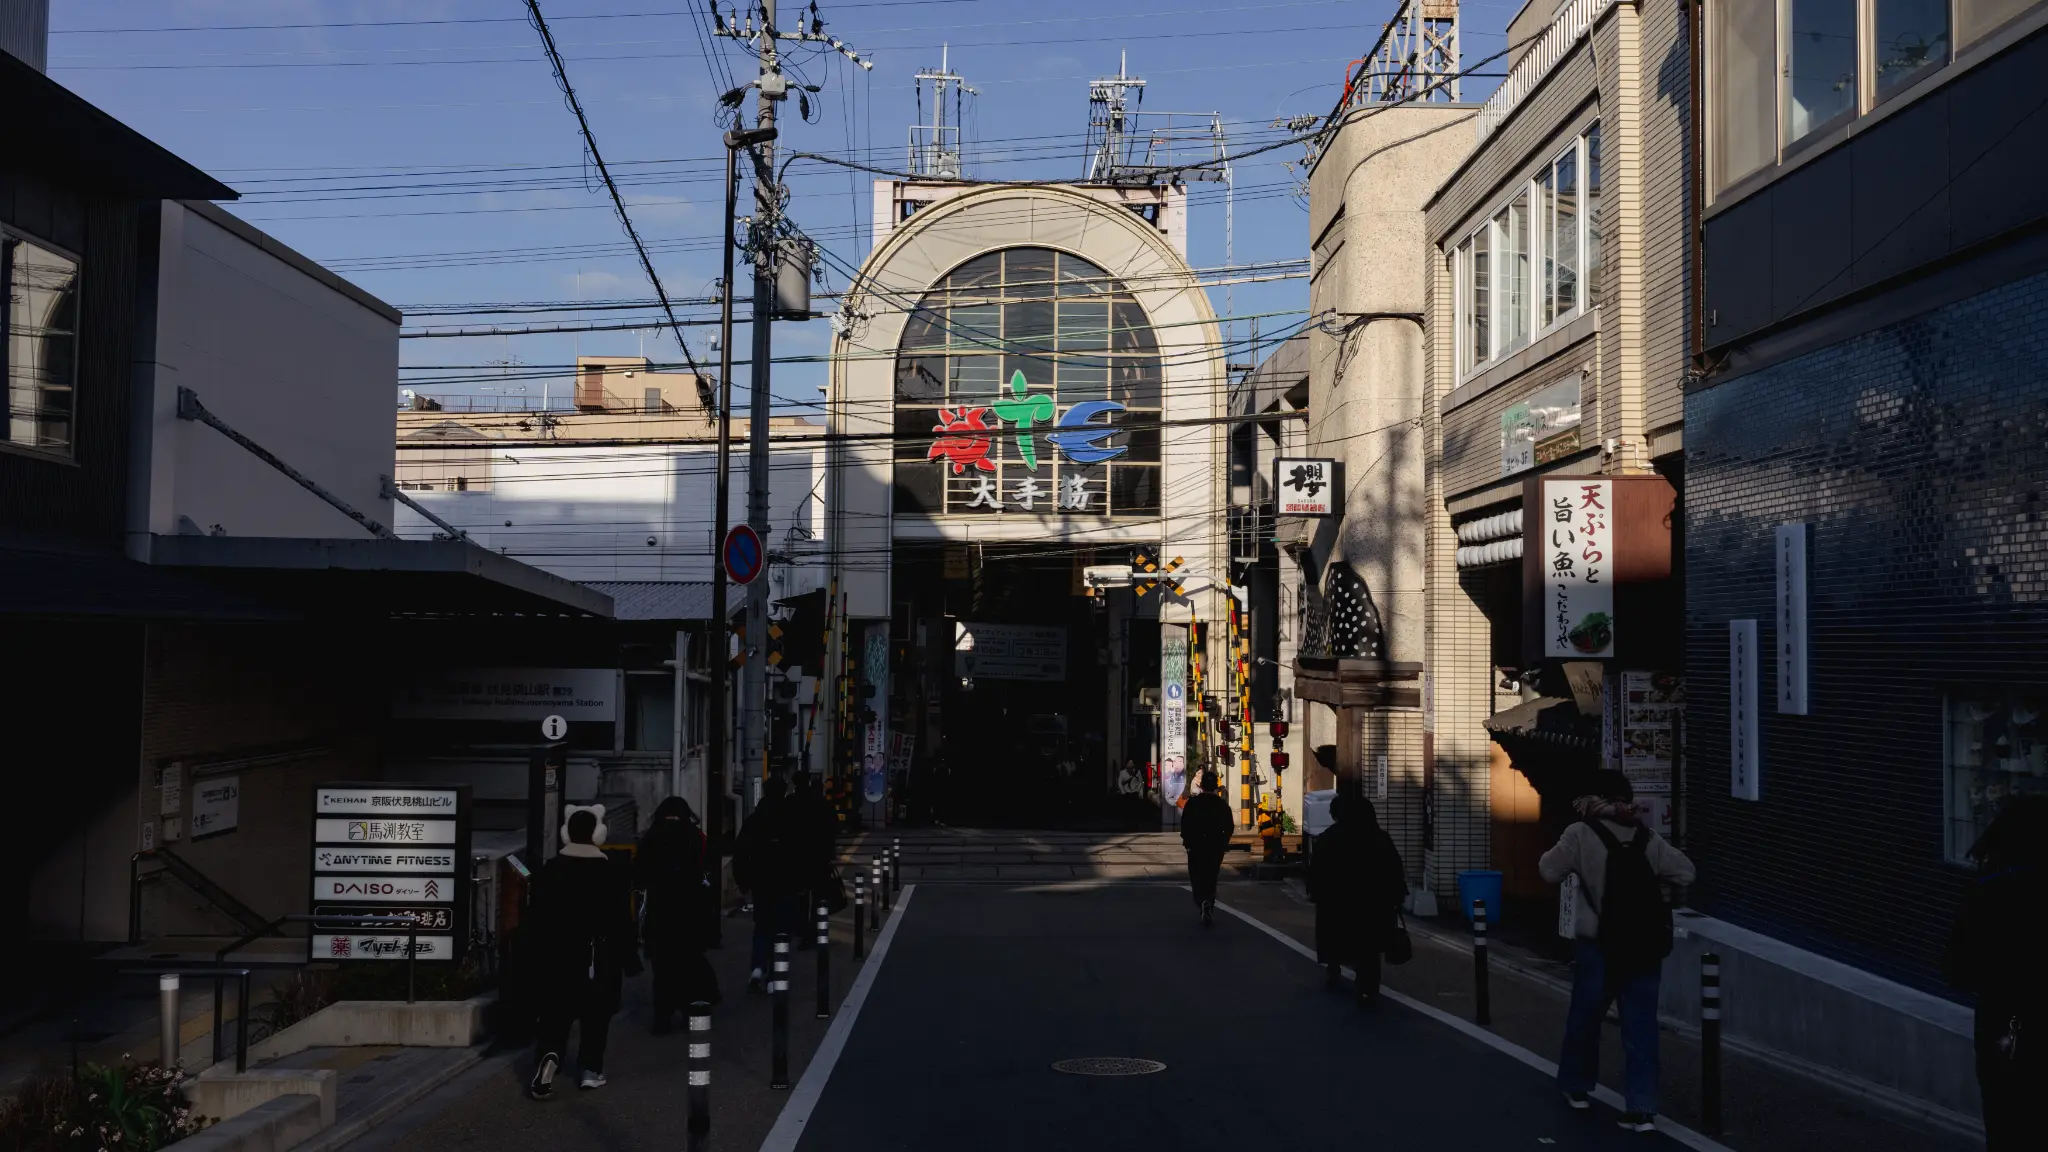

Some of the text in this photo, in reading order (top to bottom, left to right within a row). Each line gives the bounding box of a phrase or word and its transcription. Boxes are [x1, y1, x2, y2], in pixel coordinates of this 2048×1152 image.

[1283, 463, 1327, 497] 櫻
[965, 473, 1090, 511] 大手筋
[1552, 497, 1576, 578] 旨い魚
[1579, 484, 1606, 583] 天ぷらと
[575, 699, 604, 707] Station
[371, 796, 452, 807] 京阪伏見桃山ビル
[333, 855, 451, 866] ANYTIME FITNESS
[334, 883, 394, 895] DAISO
[332, 937, 350, 956] 薬
